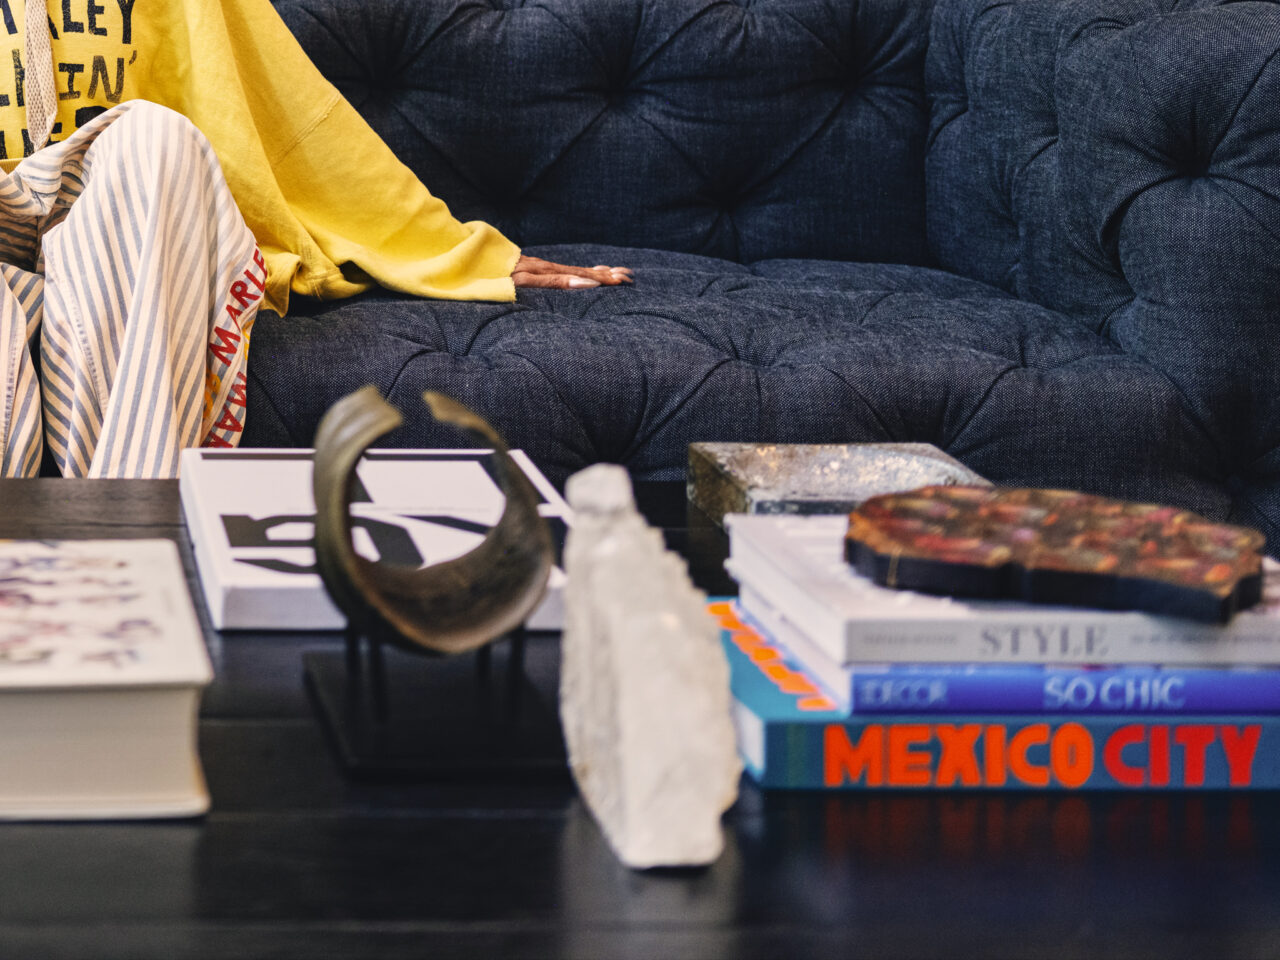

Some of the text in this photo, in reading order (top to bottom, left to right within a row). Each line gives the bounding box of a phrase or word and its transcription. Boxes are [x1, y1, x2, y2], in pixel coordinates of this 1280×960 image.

[979, 624, 1111, 657] STYLE
[1043, 676, 1096, 709] SO
[1099, 676, 1186, 709] CHIC
[824, 722, 1263, 789] MEXICO CITY
